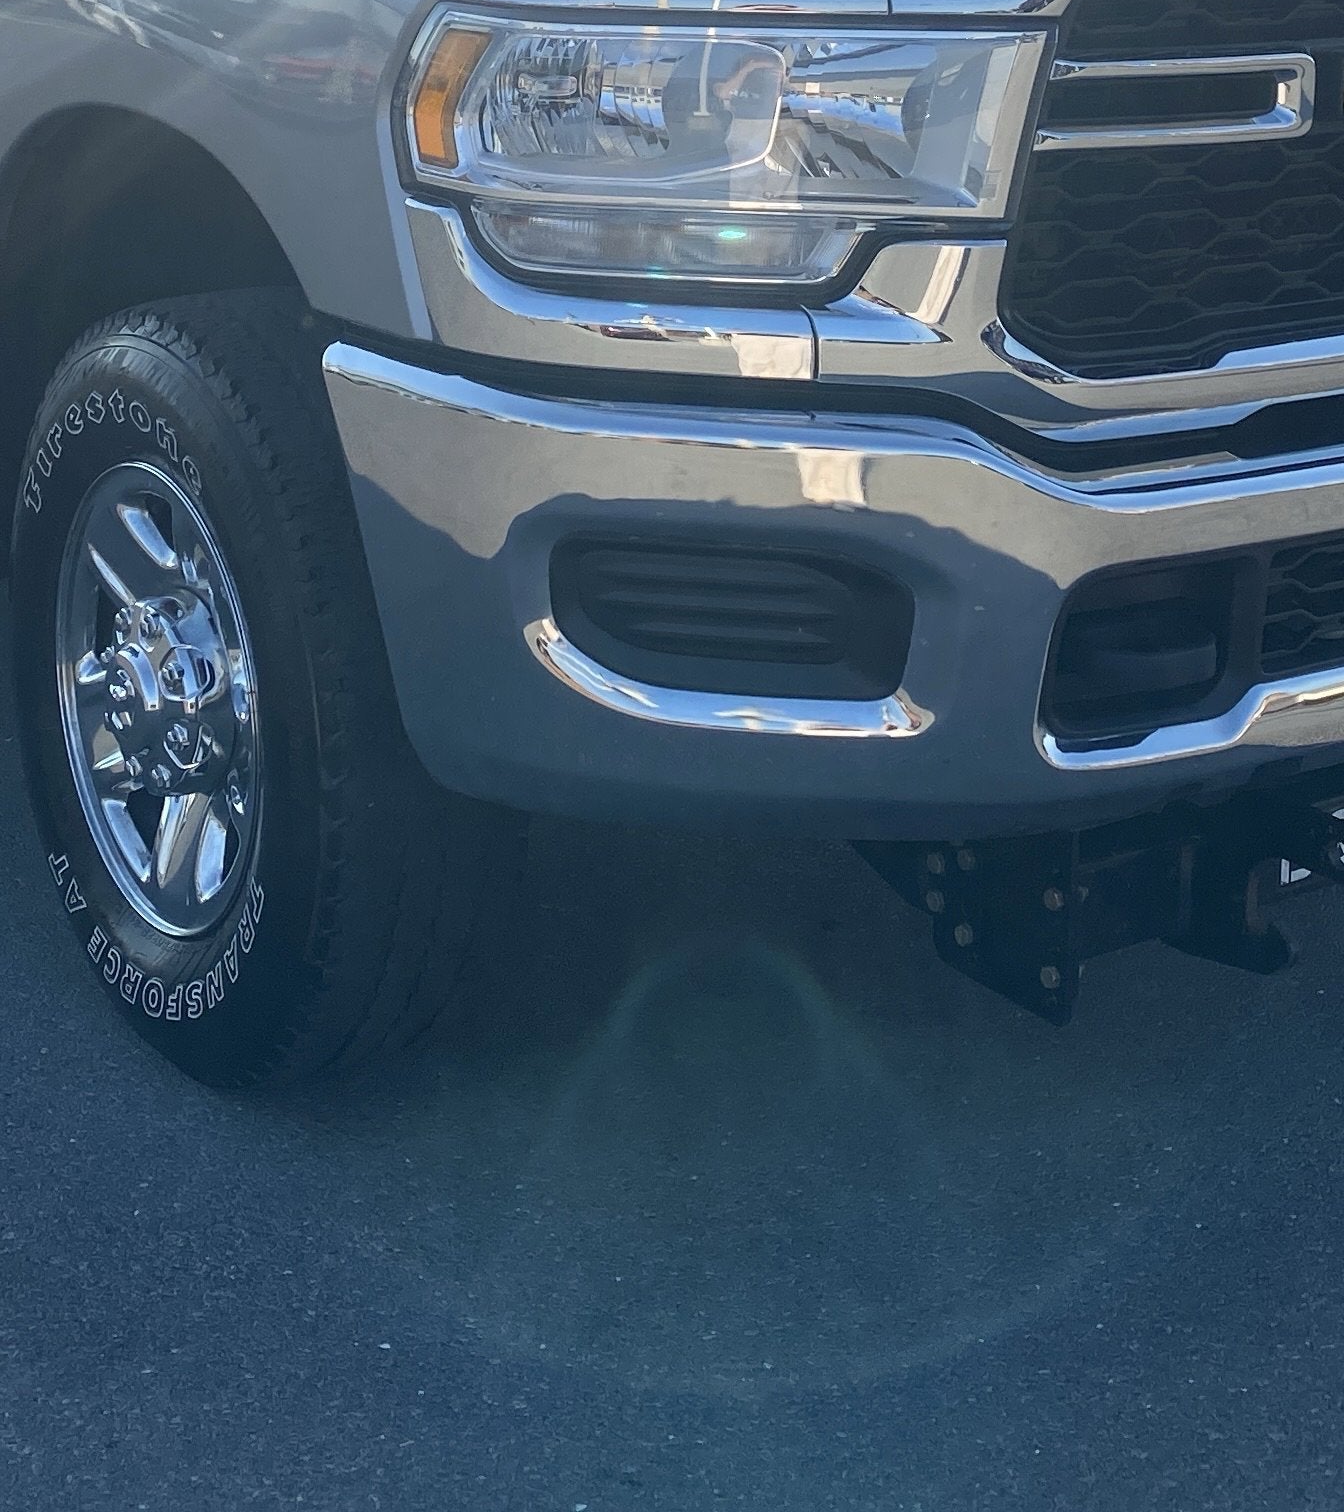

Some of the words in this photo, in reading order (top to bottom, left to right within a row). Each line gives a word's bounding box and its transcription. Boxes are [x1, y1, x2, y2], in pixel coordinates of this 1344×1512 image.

[23, 389, 203, 514] Firestone
[48, 852, 88, 914] AT
[86, 876, 265, 1021] TRANSFORCE
